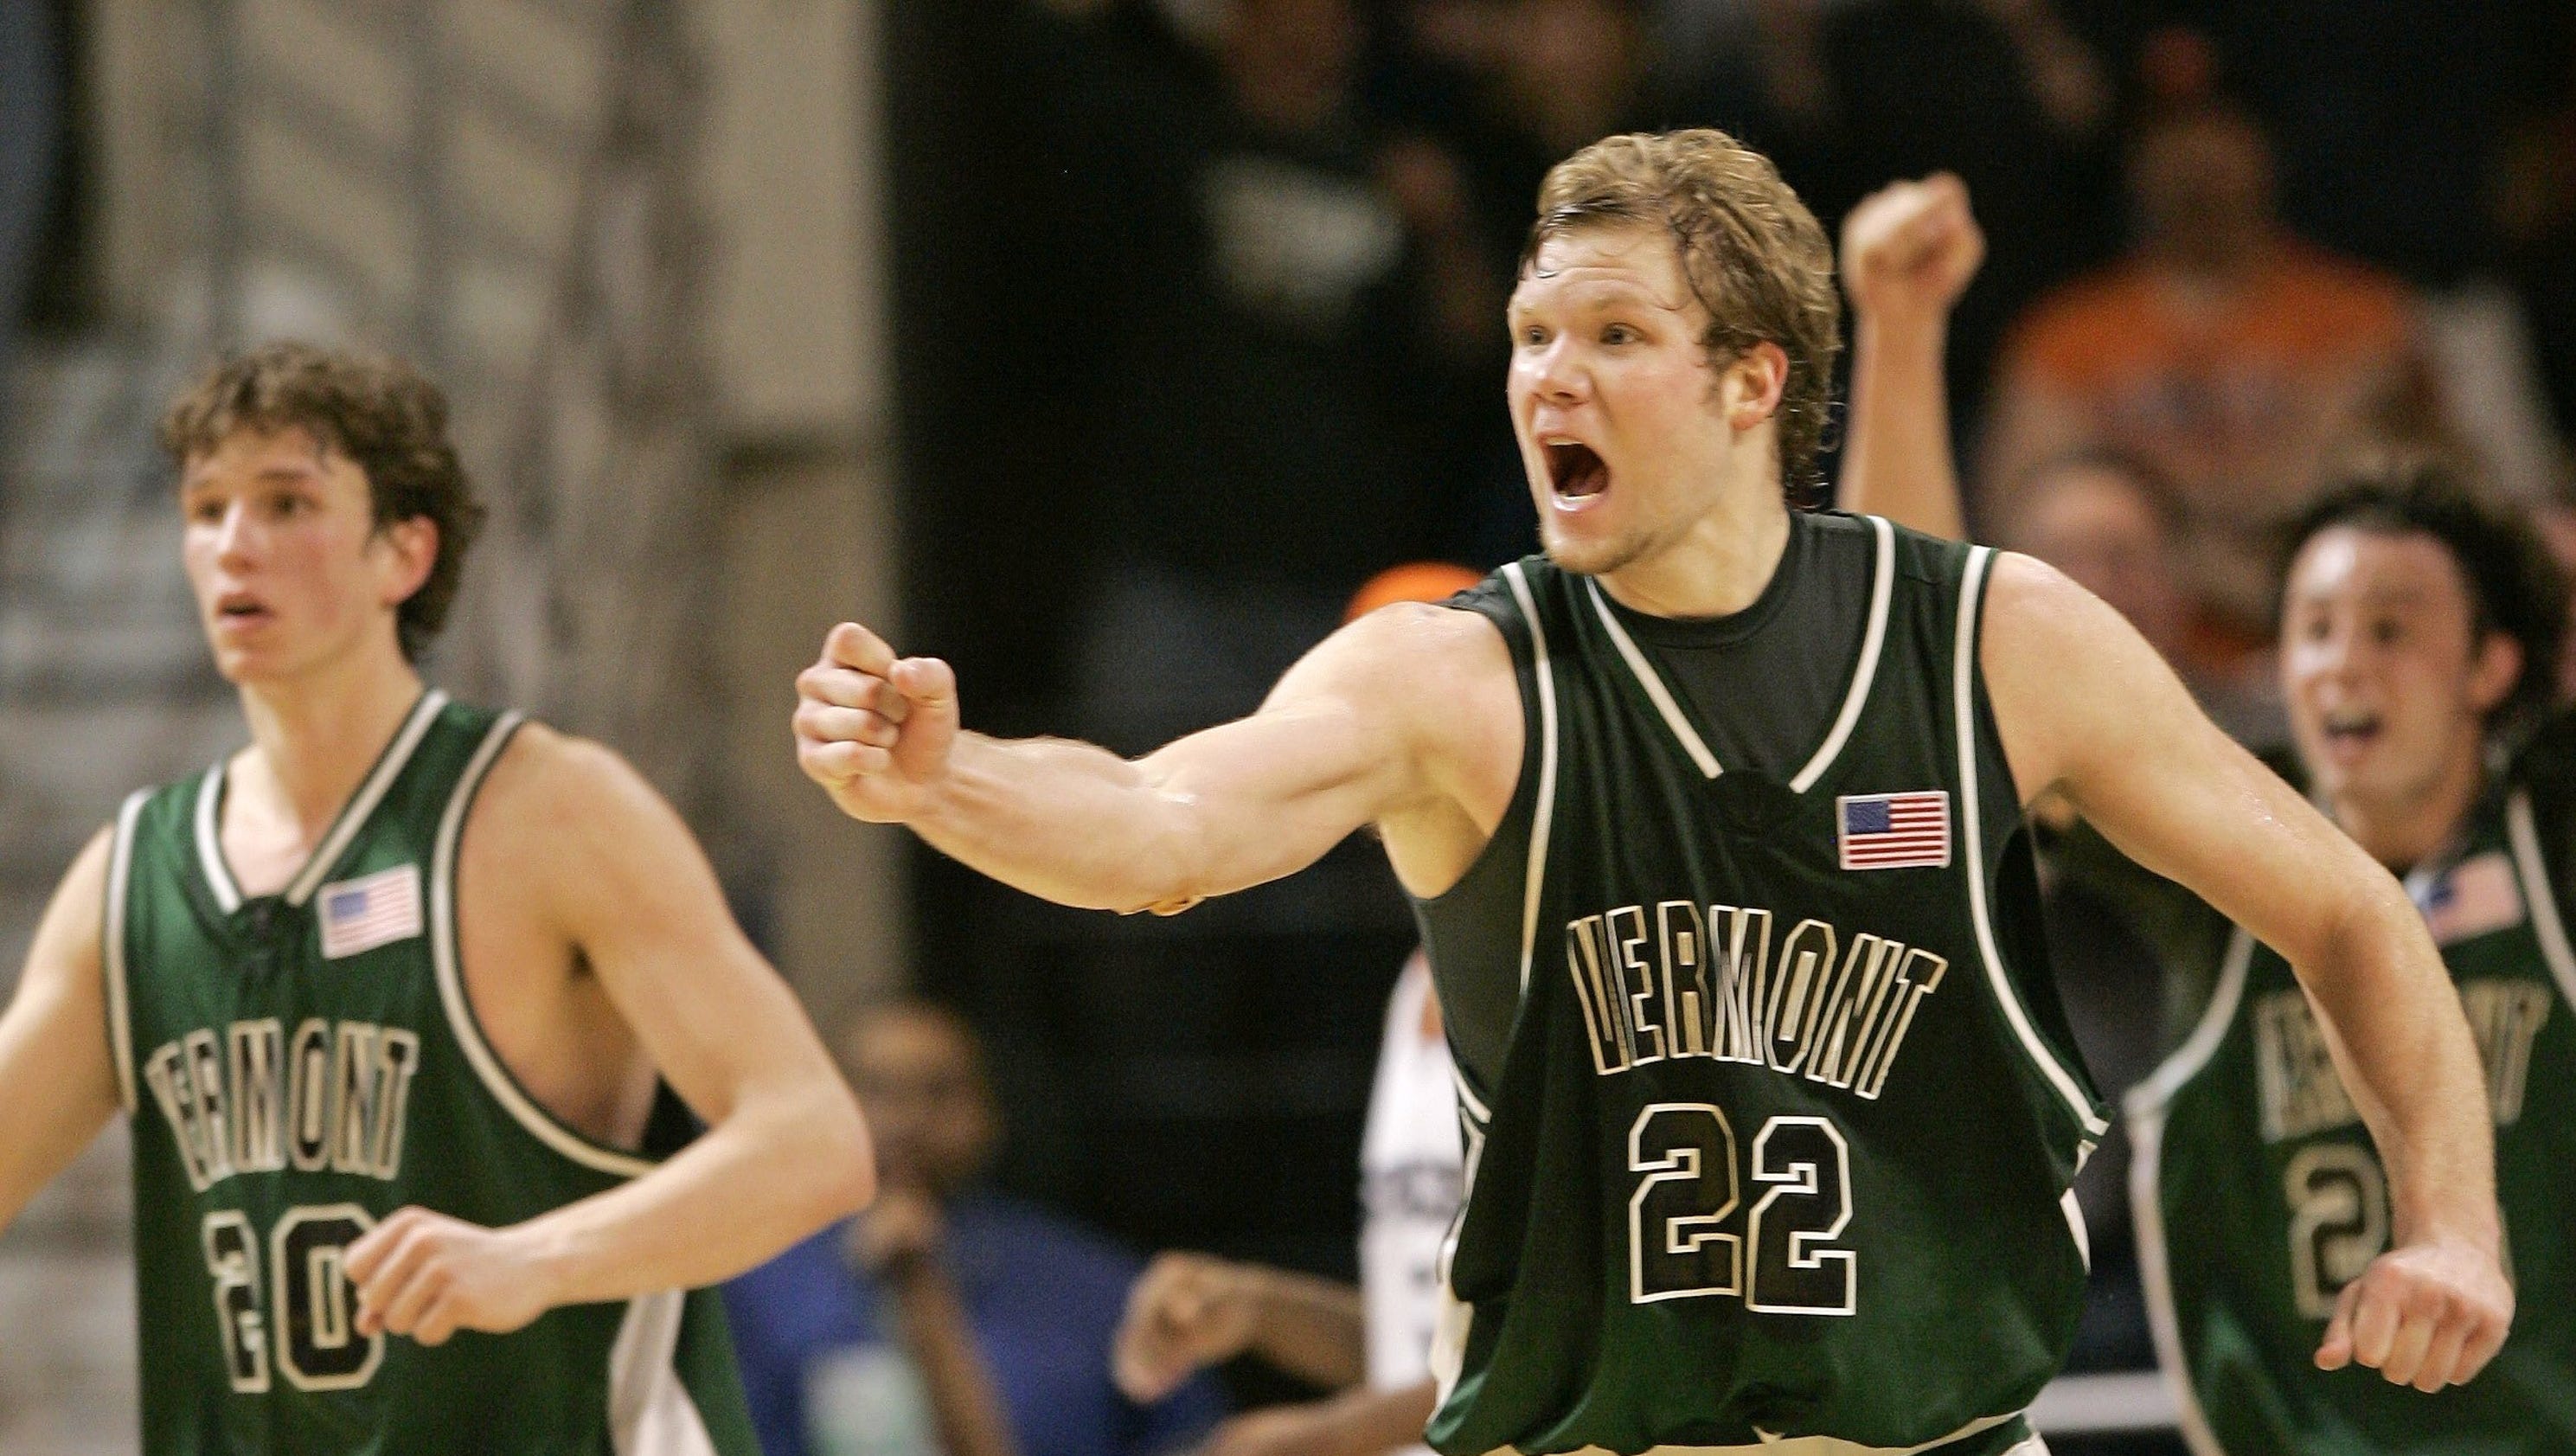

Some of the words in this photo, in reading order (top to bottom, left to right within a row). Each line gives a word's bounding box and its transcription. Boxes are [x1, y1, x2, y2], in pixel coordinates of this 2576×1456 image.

[1567, 900, 1948, 1100] VERMONT
[201, 1203, 386, 1394] 20
[1629, 1103, 1856, 1315] 22
